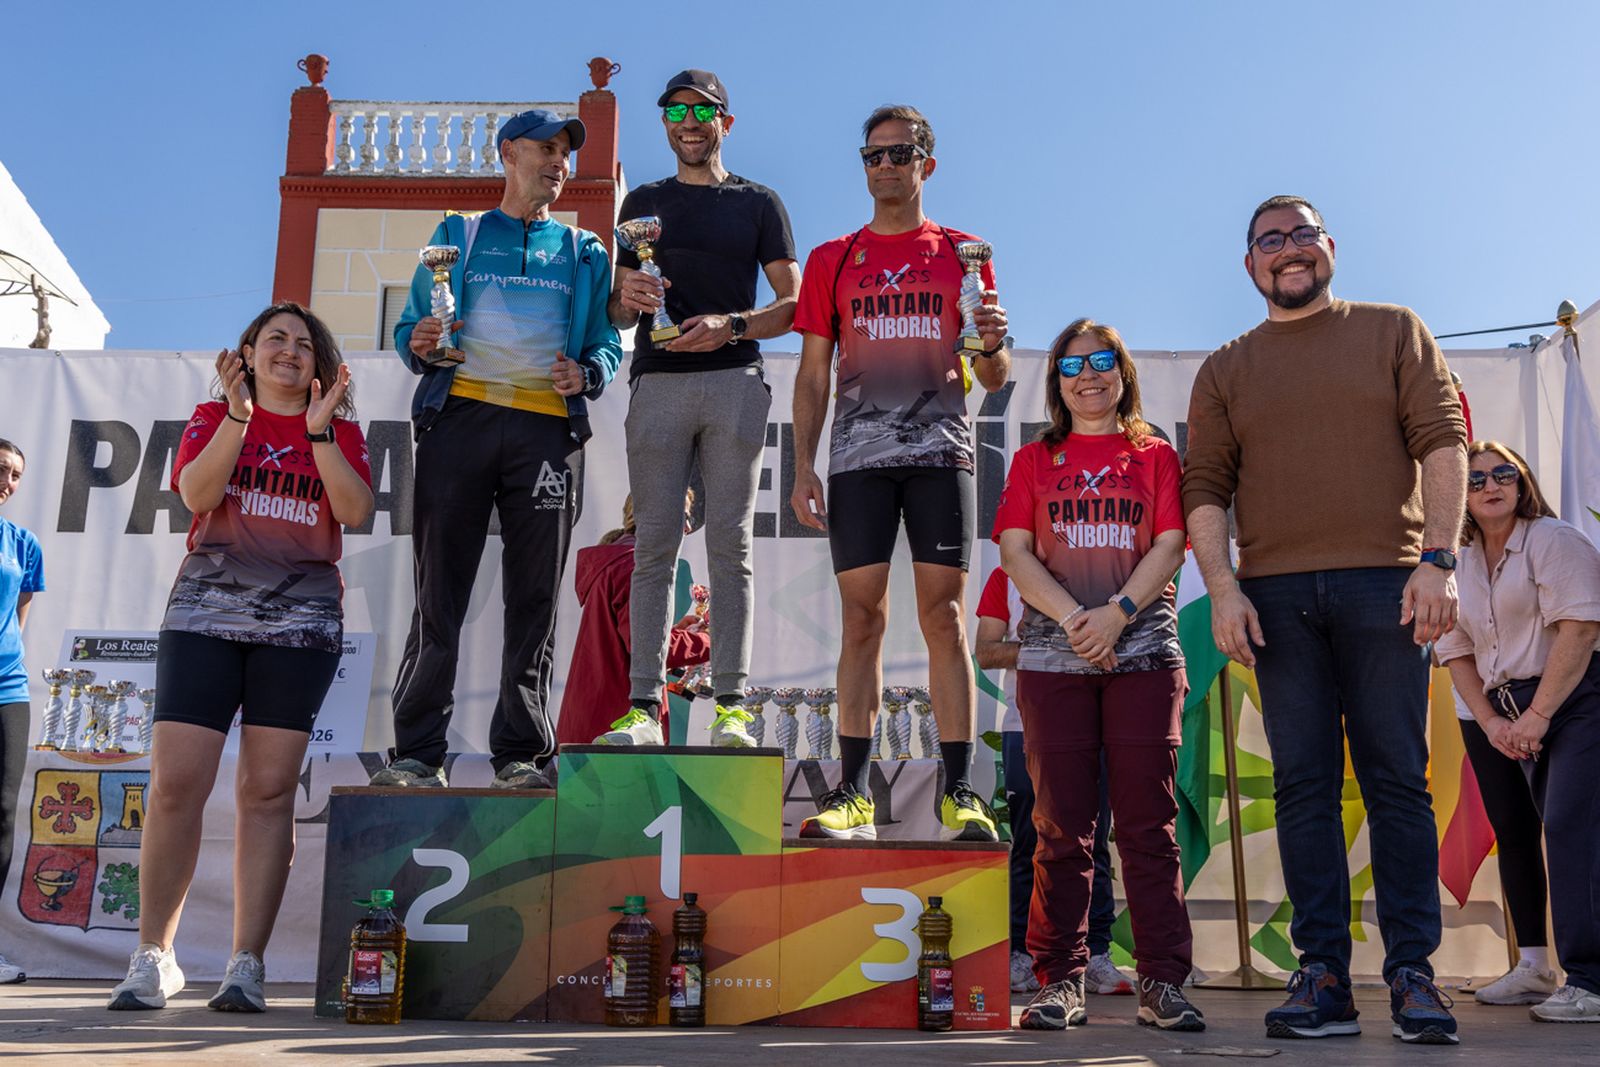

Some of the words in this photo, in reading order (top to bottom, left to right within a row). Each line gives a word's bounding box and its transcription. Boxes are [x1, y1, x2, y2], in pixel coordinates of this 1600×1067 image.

[859, 266, 932, 291] CROSS
[851, 292, 943, 318] PANTANO
[867, 313, 942, 341] VÍBORAS
[1057, 470, 1133, 493] CROSS
[241, 487, 320, 527] VÍBORAS
[1048, 498, 1144, 526] PANTANO
[96, 639, 118, 651] Los
[121, 639, 159, 651] Reales
[337, 667, 346, 679] €
[642, 804, 683, 900] 1
[404, 847, 470, 943] 2
[860, 887, 925, 982] 3
[704, 977, 772, 989] EPORTES
